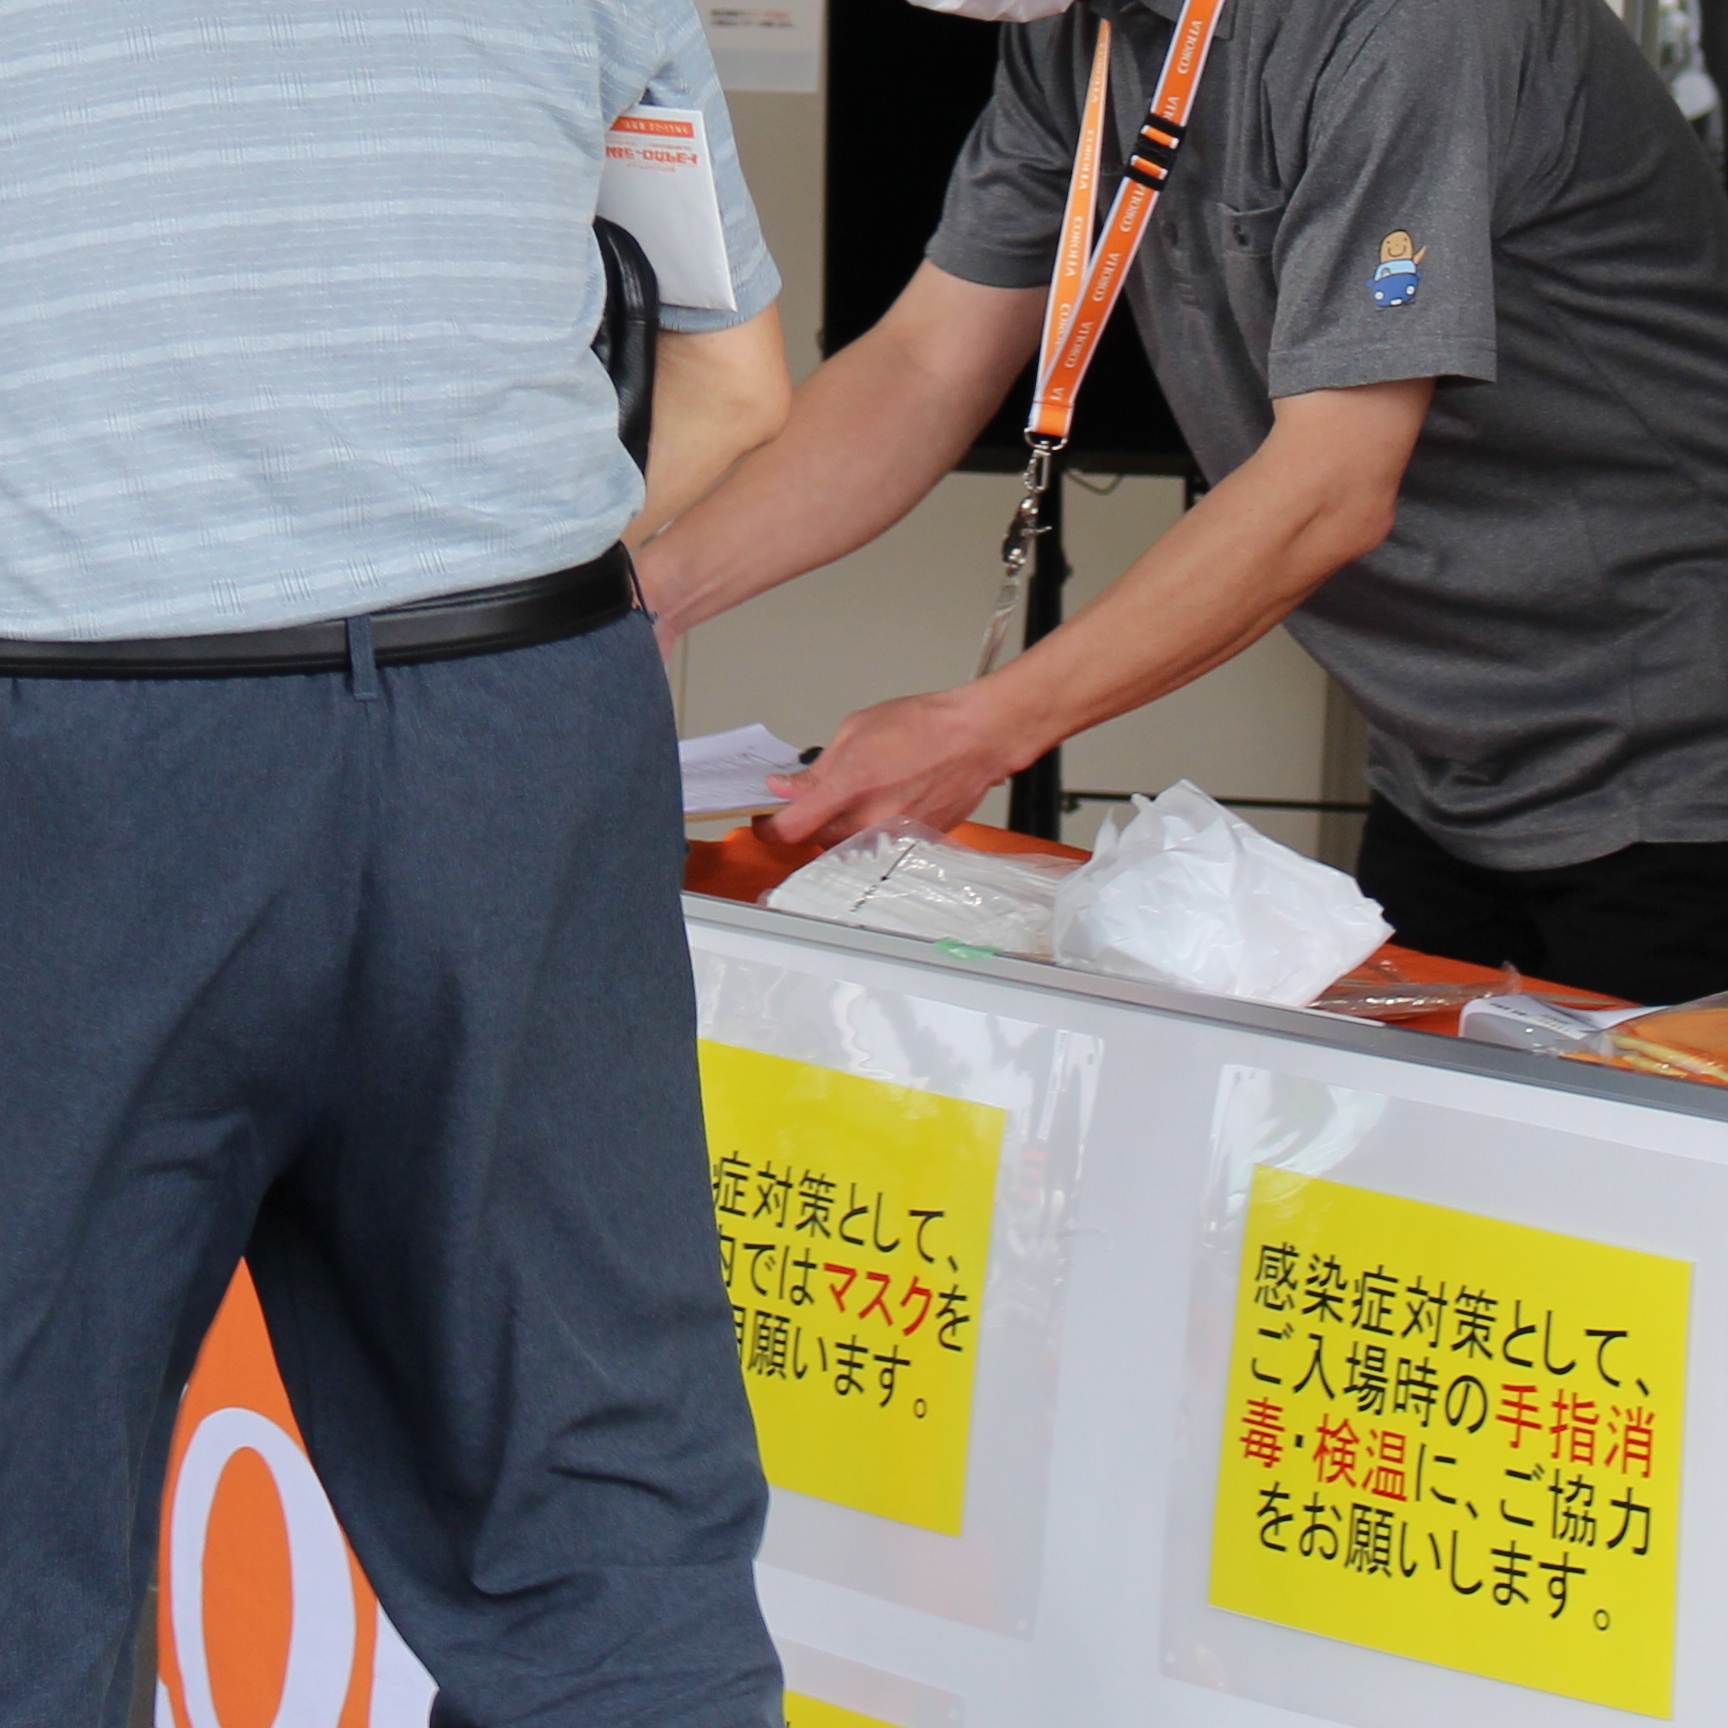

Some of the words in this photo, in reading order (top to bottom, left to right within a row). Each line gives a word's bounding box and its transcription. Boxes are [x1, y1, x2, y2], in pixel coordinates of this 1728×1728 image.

[1176, 20, 1203, 75] COROLLA
[1079, 129, 1095, 190] COROLLA
[1066, 216, 1082, 277] COROLLA
[1090, 252, 1120, 302] COROLLA
[1064, 321, 1093, 369] COROLLA
[712, 1150, 960, 1273] 症対策として、
[1253, 1241, 1651, 1399] 感染症対策として、
[1249, 1320, 1657, 1479] ご入場時の手指消
[1238, 1396, 1653, 1557] 毒・検温に、ご協力
[1254, 1478, 1612, 1632] をお願いします。
